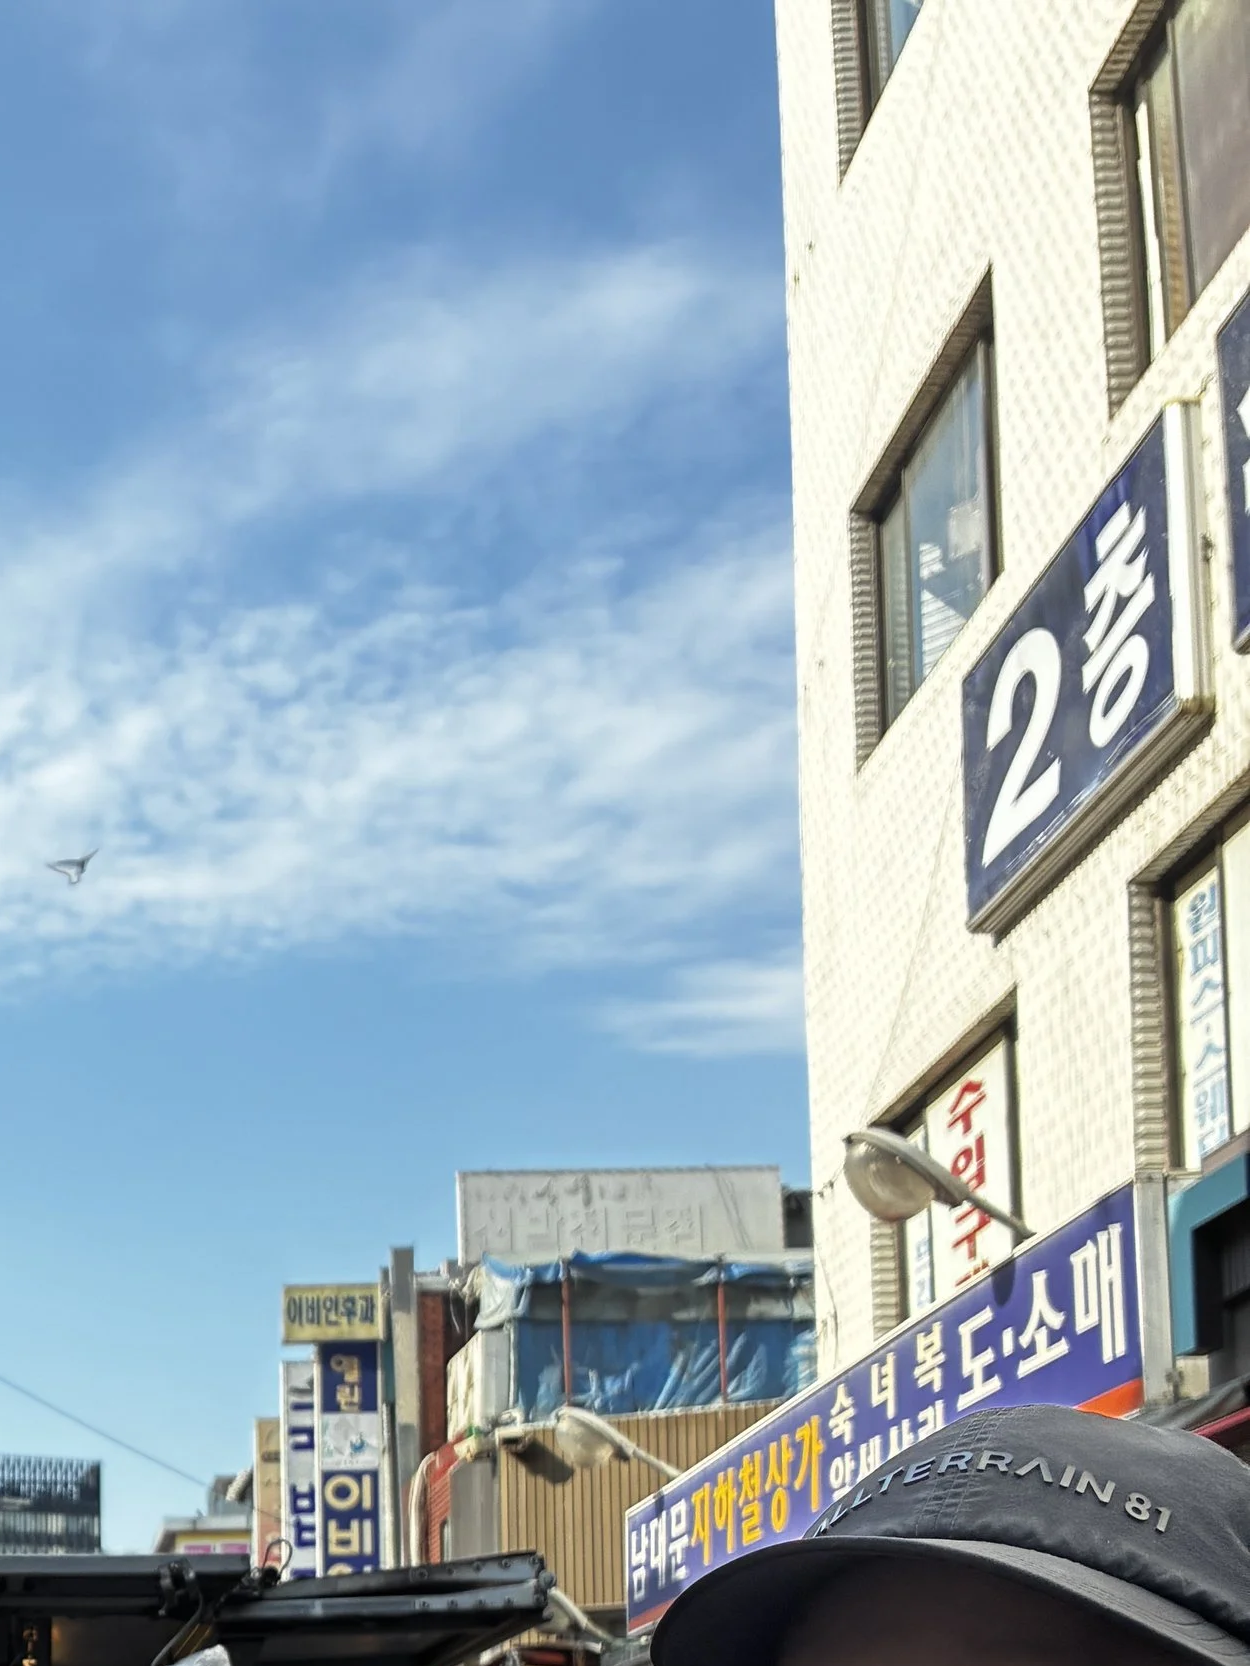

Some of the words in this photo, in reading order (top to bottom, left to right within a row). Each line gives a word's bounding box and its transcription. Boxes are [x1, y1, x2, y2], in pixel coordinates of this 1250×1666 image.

[981, 501, 1155, 868] 2층
[947, 1080, 993, 1287] 수입구
[287, 1296, 375, 1326] 이비인후과
[957, 1223, 1129, 1412] 도·소매
[876, 1449, 1118, 1504] TERRAIN
[1124, 1492, 1173, 1533] 81
